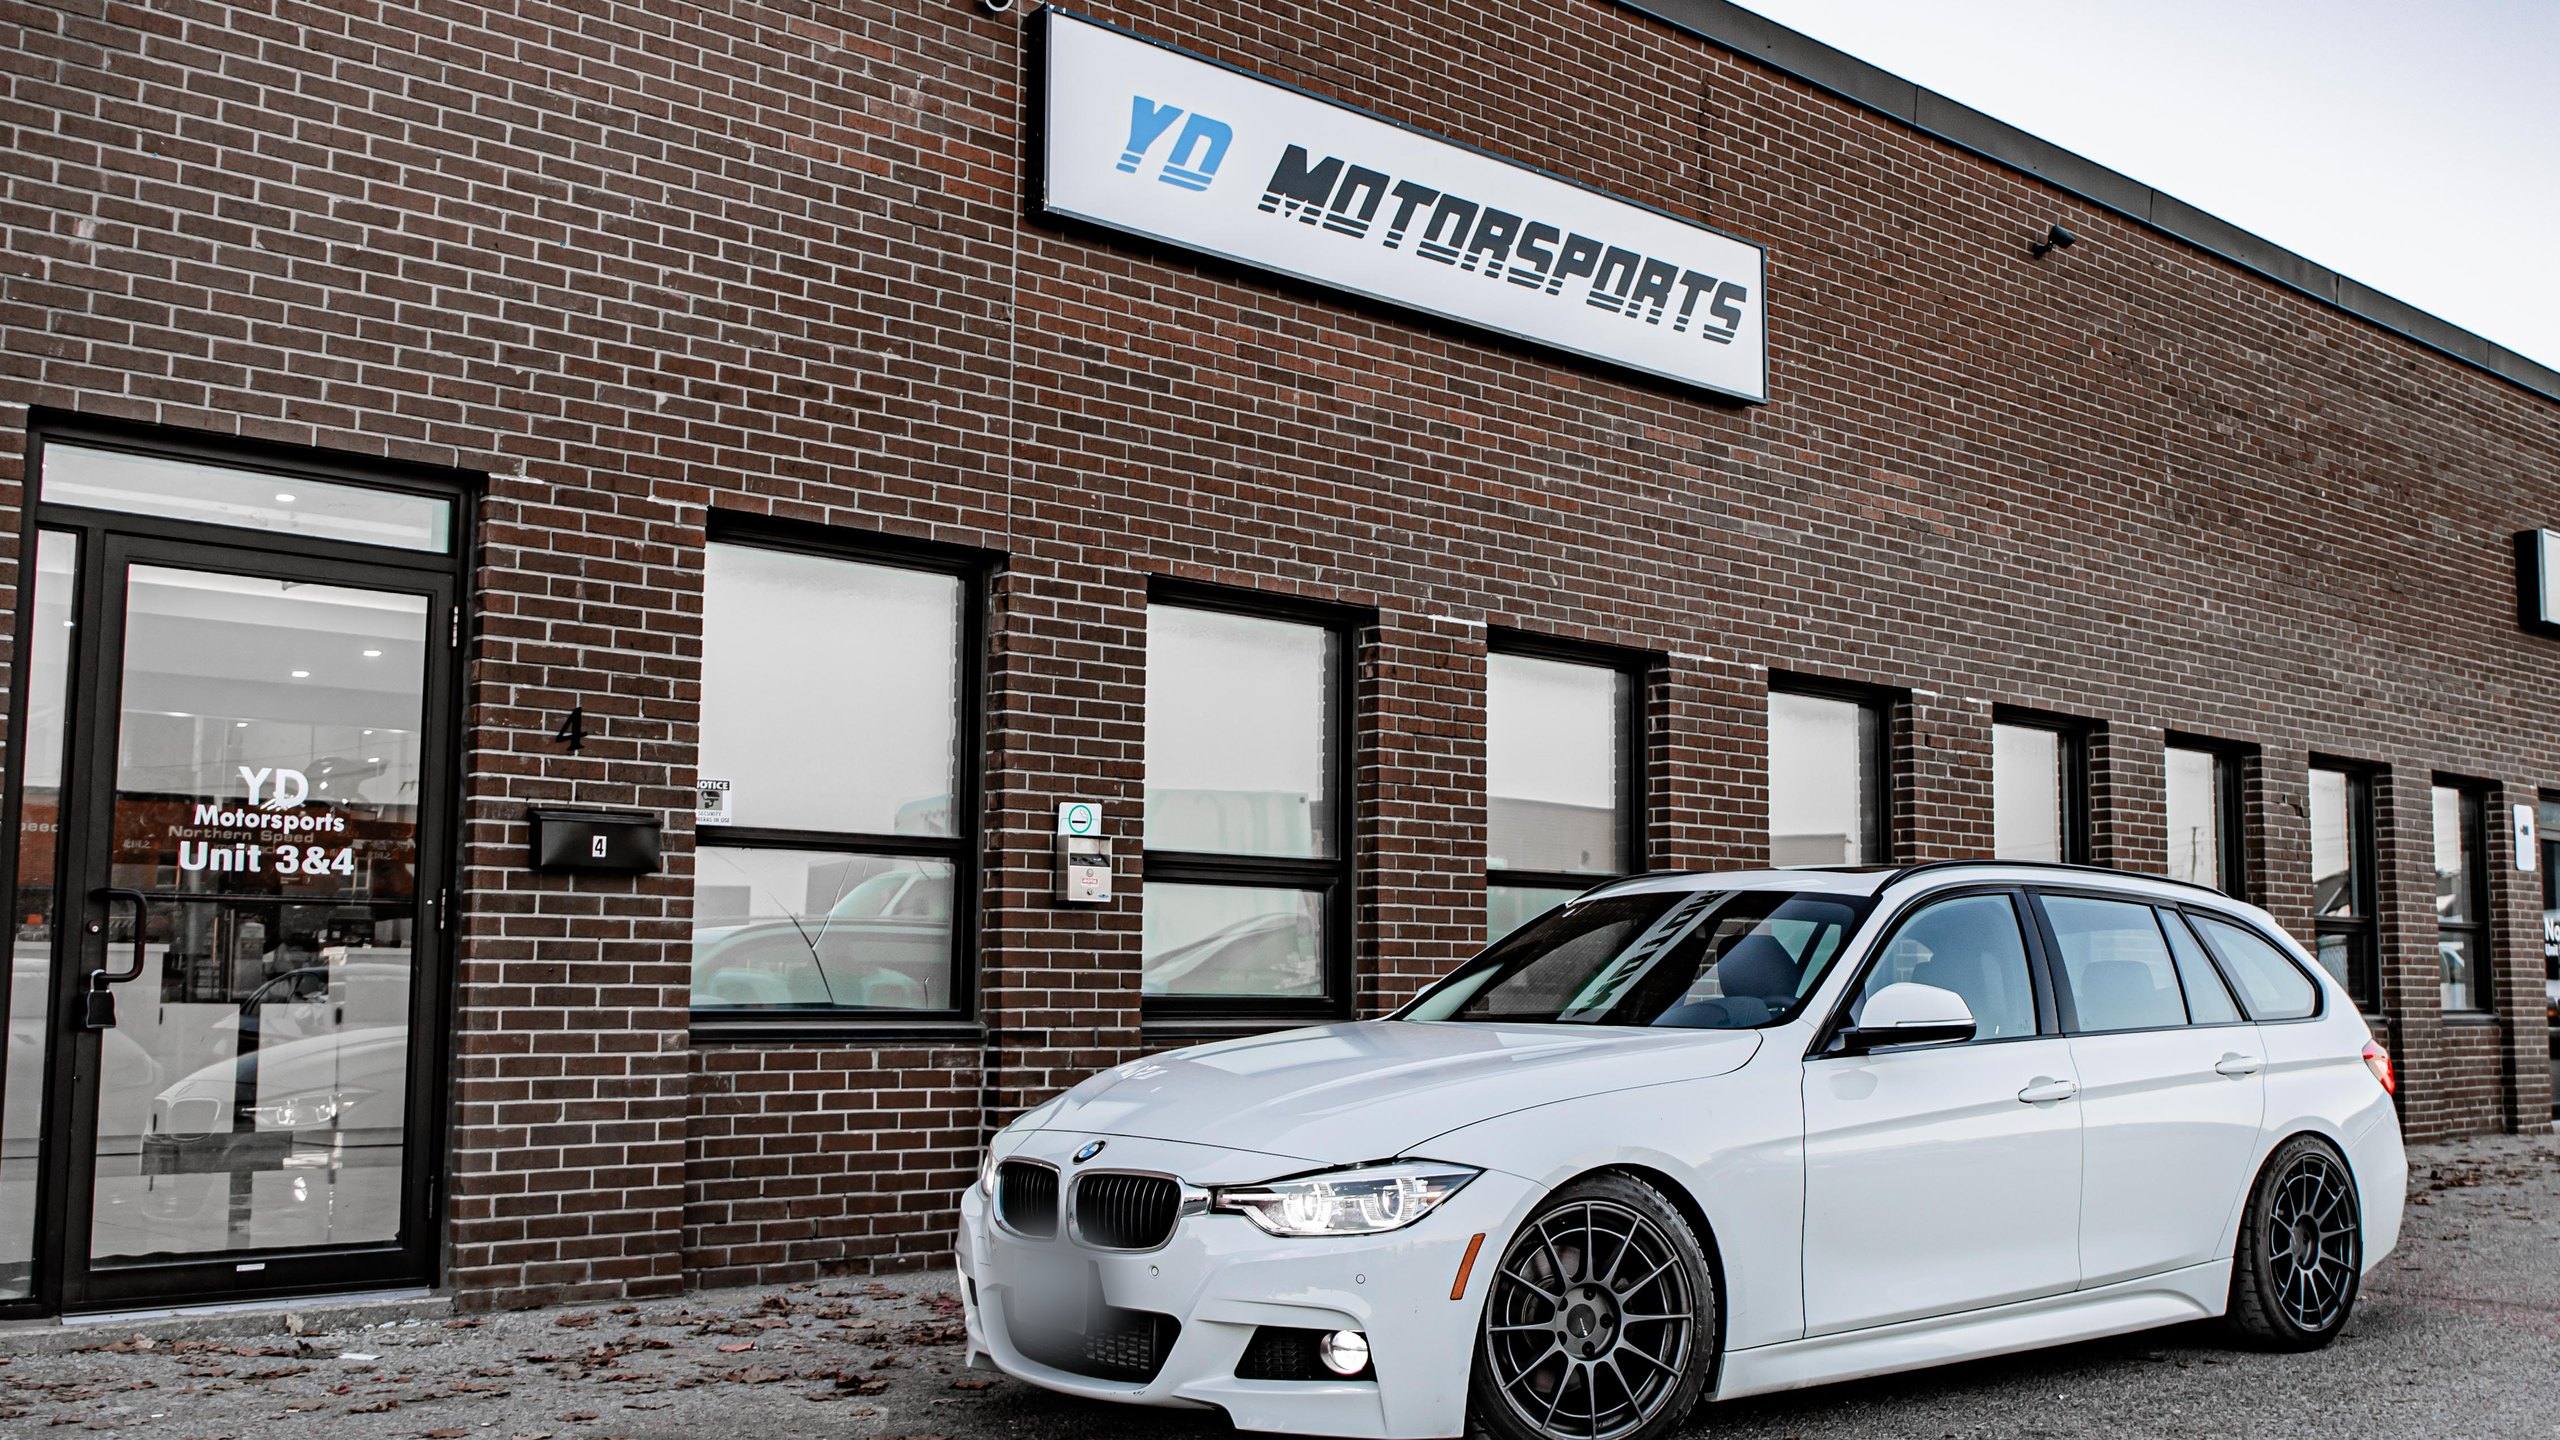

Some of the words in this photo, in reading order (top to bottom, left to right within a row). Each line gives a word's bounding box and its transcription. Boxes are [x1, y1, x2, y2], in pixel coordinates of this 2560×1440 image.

[1117, 96, 1233, 191] YD
[1258, 144, 1747, 344] MOTORSPORTS
[556, 707, 588, 751] 4
[238, 766, 309, 811] YD
[168, 826, 252, 841] Northern
[260, 830, 315, 846] Speed
[194, 804, 345, 834] Motorsports
[180, 841, 262, 873] Unit
[275, 845, 354, 876] 3&4
[594, 838, 604, 856] 4
